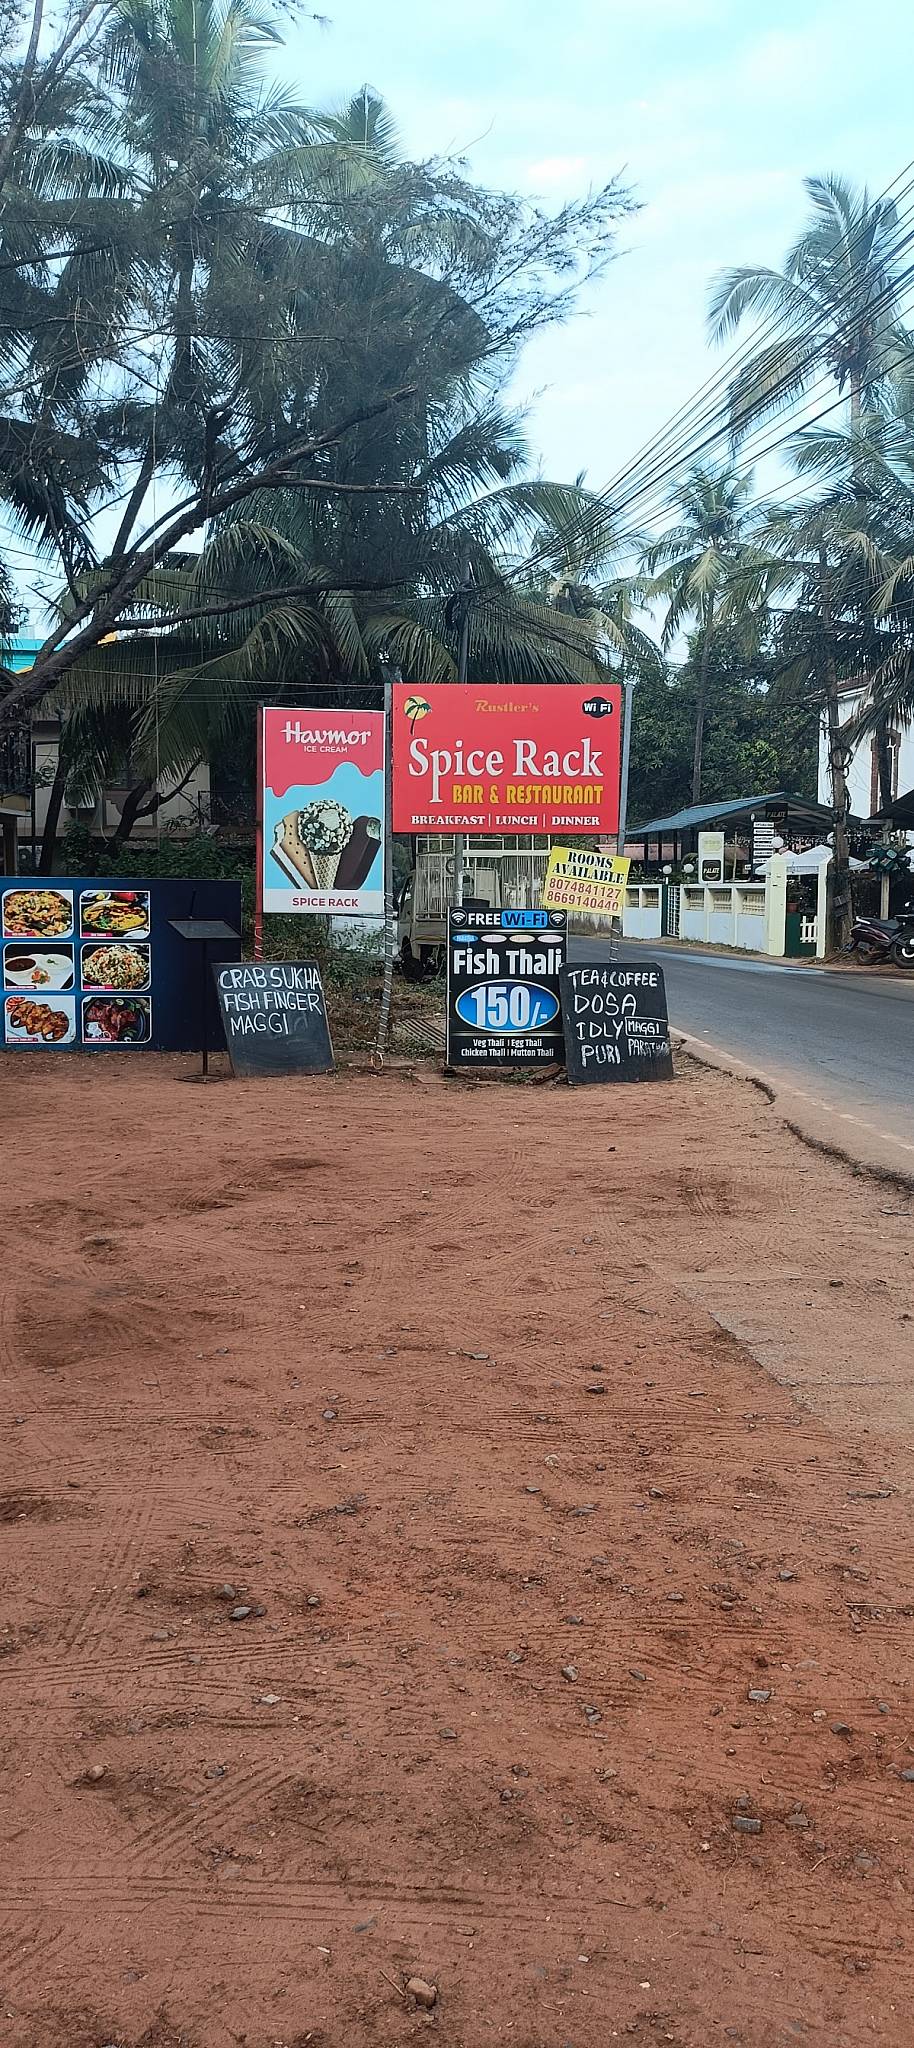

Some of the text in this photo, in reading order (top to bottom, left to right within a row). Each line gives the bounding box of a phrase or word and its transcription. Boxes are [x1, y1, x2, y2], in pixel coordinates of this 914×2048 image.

[475, 699, 539, 713] Rustler's
[584, 702, 611, 713] Wi Fi
[280, 721, 372, 745] Havmor
[408, 737, 603, 803] Spice Rack
[452, 785, 603, 805] BAR & RESTAURANT
[411, 815, 600, 826] BREAKFAST LUNCH DINNER
[567, 852, 614, 869] ROOMS
[552, 862, 625, 884] AVAILABLE
[549, 877, 622, 900] 8074841127
[292, 897, 359, 908] SPICE RACK
[546, 890, 619, 912] 8669140440
[468, 912, 545, 926] FREE Wi-Fi
[453, 947, 562, 975] Fish Thali
[219, 967, 323, 991] CRAB SUKHA
[223, 991, 322, 1015] FISH FINGER
[470, 986, 548, 1027] 150/-
[574, 993, 637, 1016] DOSA
[230, 1013, 289, 1036] MAGGI
[577, 1020, 624, 1040] IDLY
[628, 1020, 660, 1035] MAGGI
[461, 1048, 554, 1057] Chicken Thali Mutton Thali
[473, 1038, 542, 1048] Veg Thali Egg Thali
[581, 1045, 621, 1067] PURI
